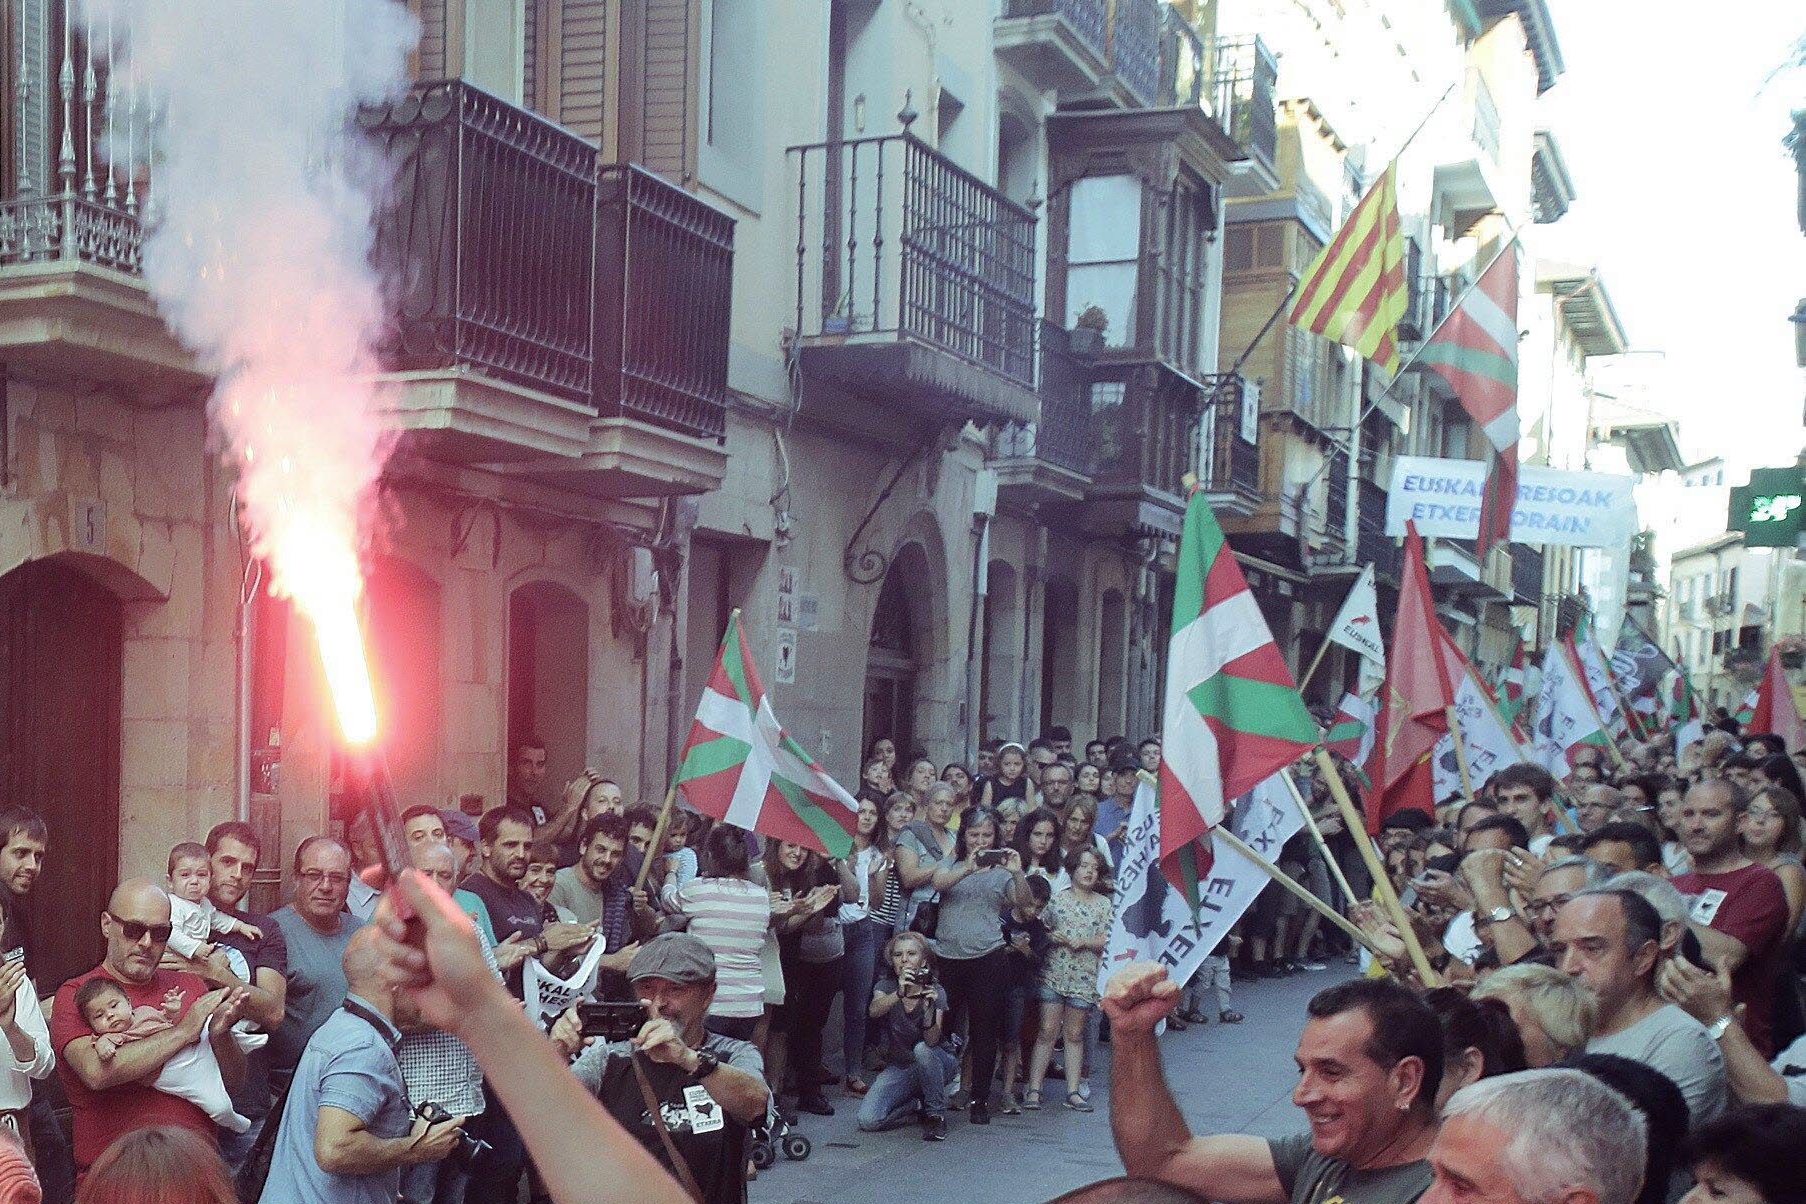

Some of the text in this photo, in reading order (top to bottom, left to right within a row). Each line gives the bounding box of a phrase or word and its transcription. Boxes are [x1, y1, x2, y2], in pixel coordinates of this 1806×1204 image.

[1518, 484, 1613, 507] RESOAK
[1412, 502, 1592, 533] ETXER ORAIN
[537, 980, 570, 996] KAL
